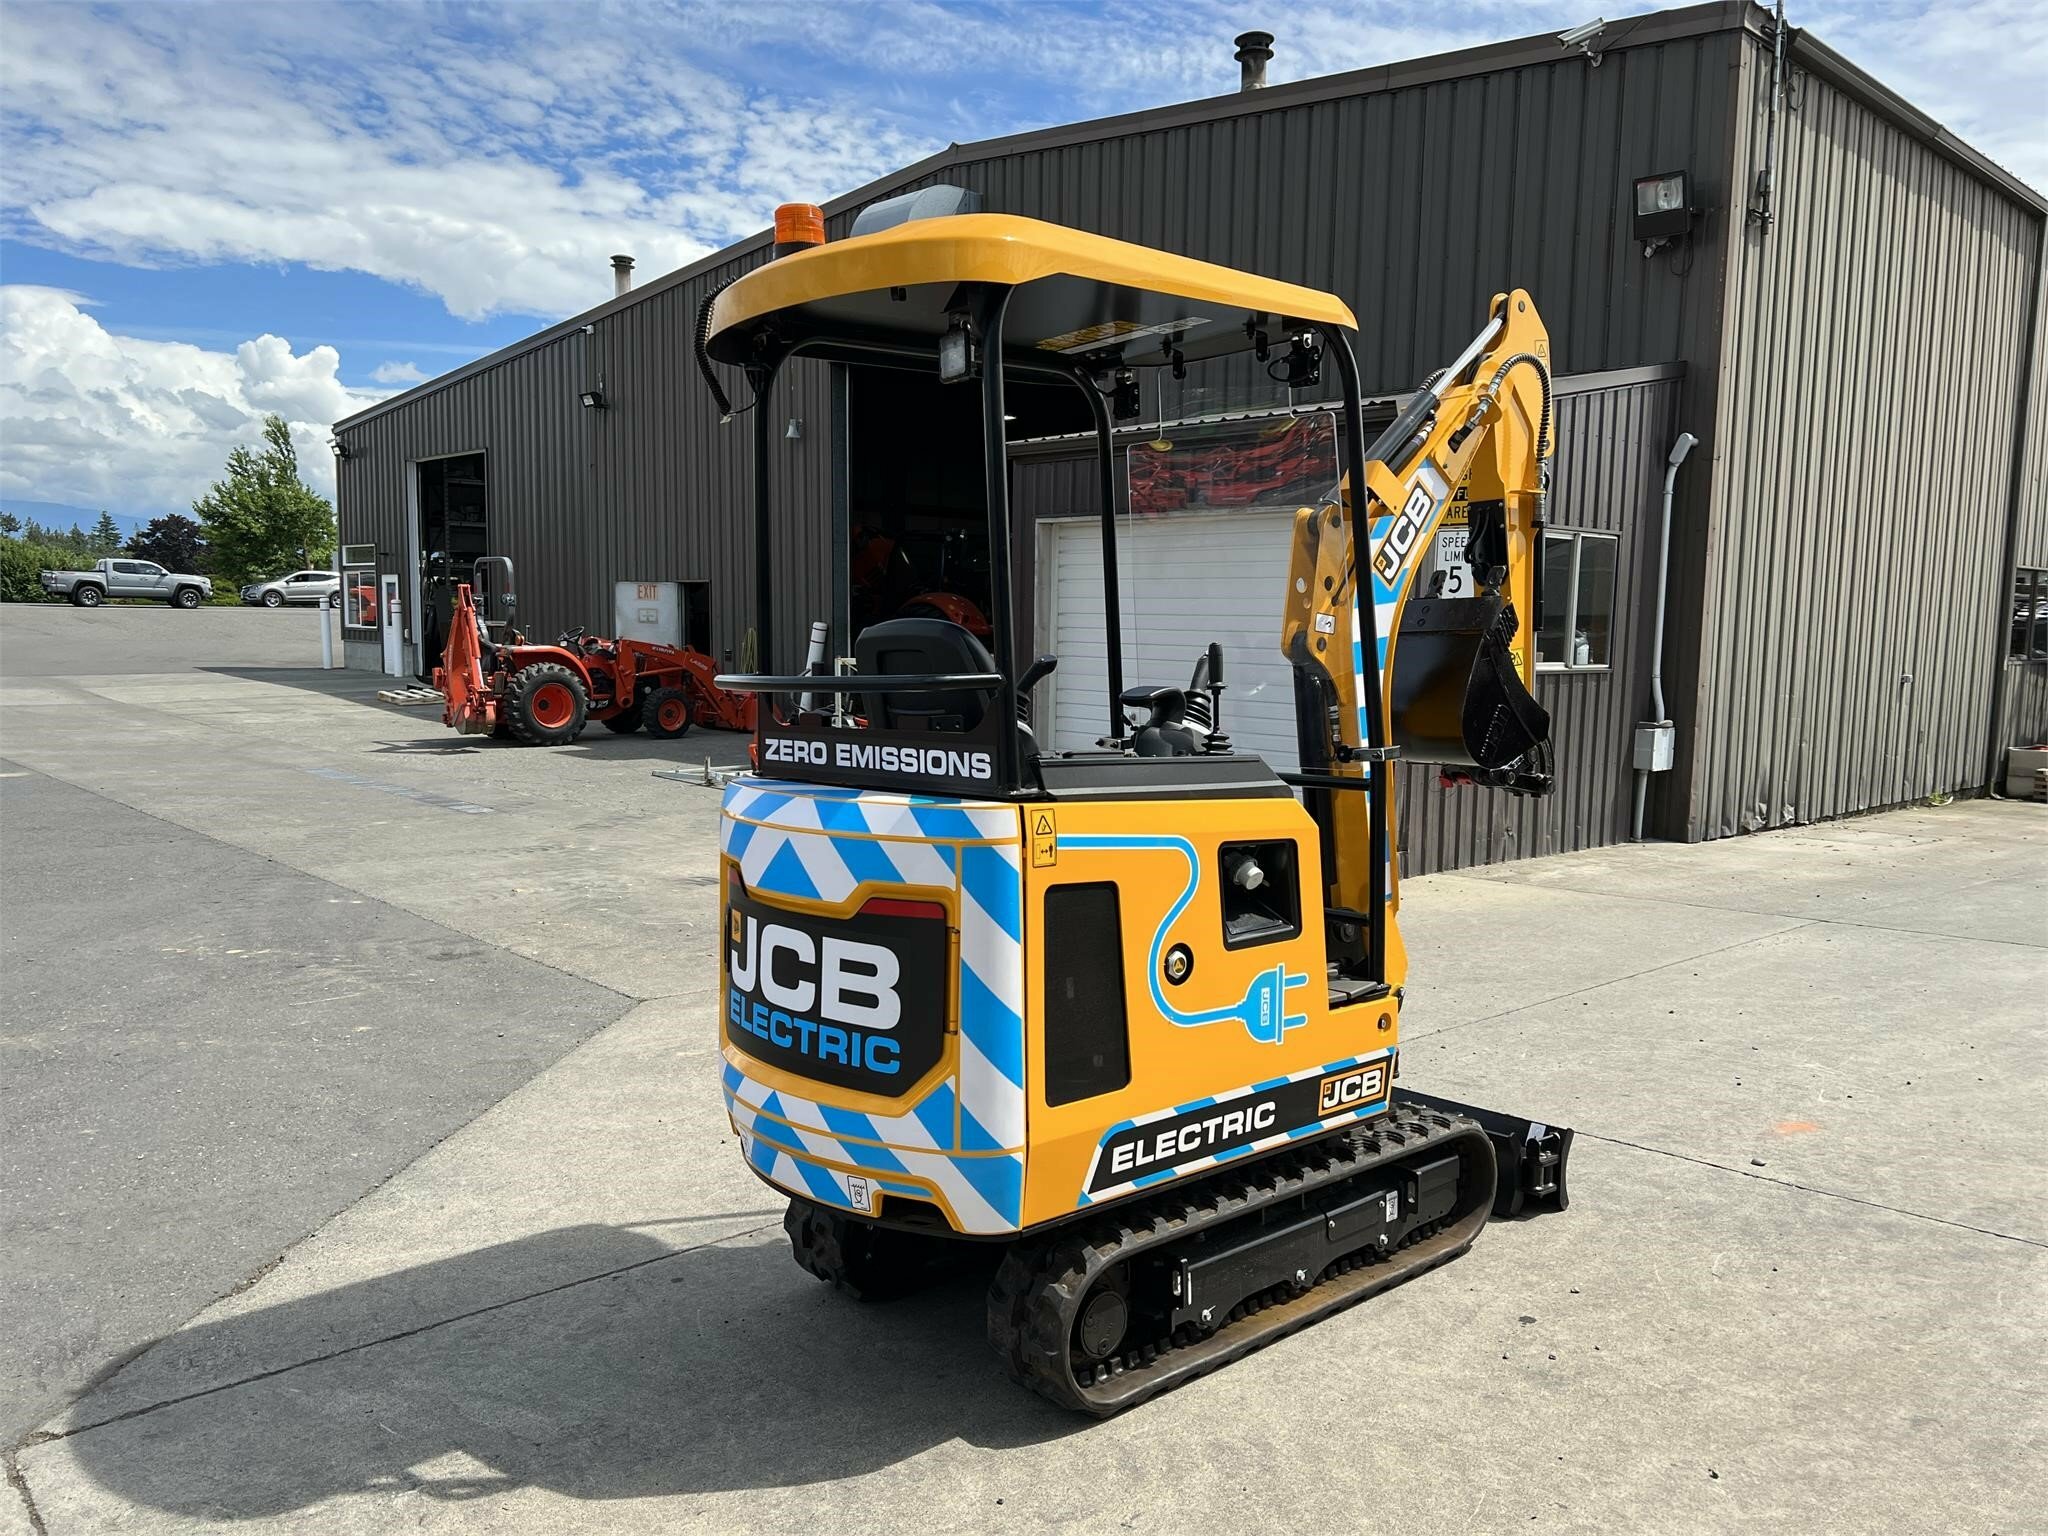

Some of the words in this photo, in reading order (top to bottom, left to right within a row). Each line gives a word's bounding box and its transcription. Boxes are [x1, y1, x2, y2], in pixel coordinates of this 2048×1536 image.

[1446, 505, 1469, 519] ARE
[1383, 487, 1431, 580] JCB
[1442, 536, 1470, 549] SPEE
[1444, 550, 1465, 562] LIMI
[637, 584, 657, 600] EXIT
[1448, 566, 1462, 594] 5
[765, 738, 828, 765] ZERO
[835, 743, 992, 779] EMISSIONS
[731, 916, 901, 1030] JCB
[730, 988, 901, 1075] ELECTRIC
[1111, 1101, 1276, 1174] ELECTRIC
[1323, 1069, 1382, 1108] JCB
